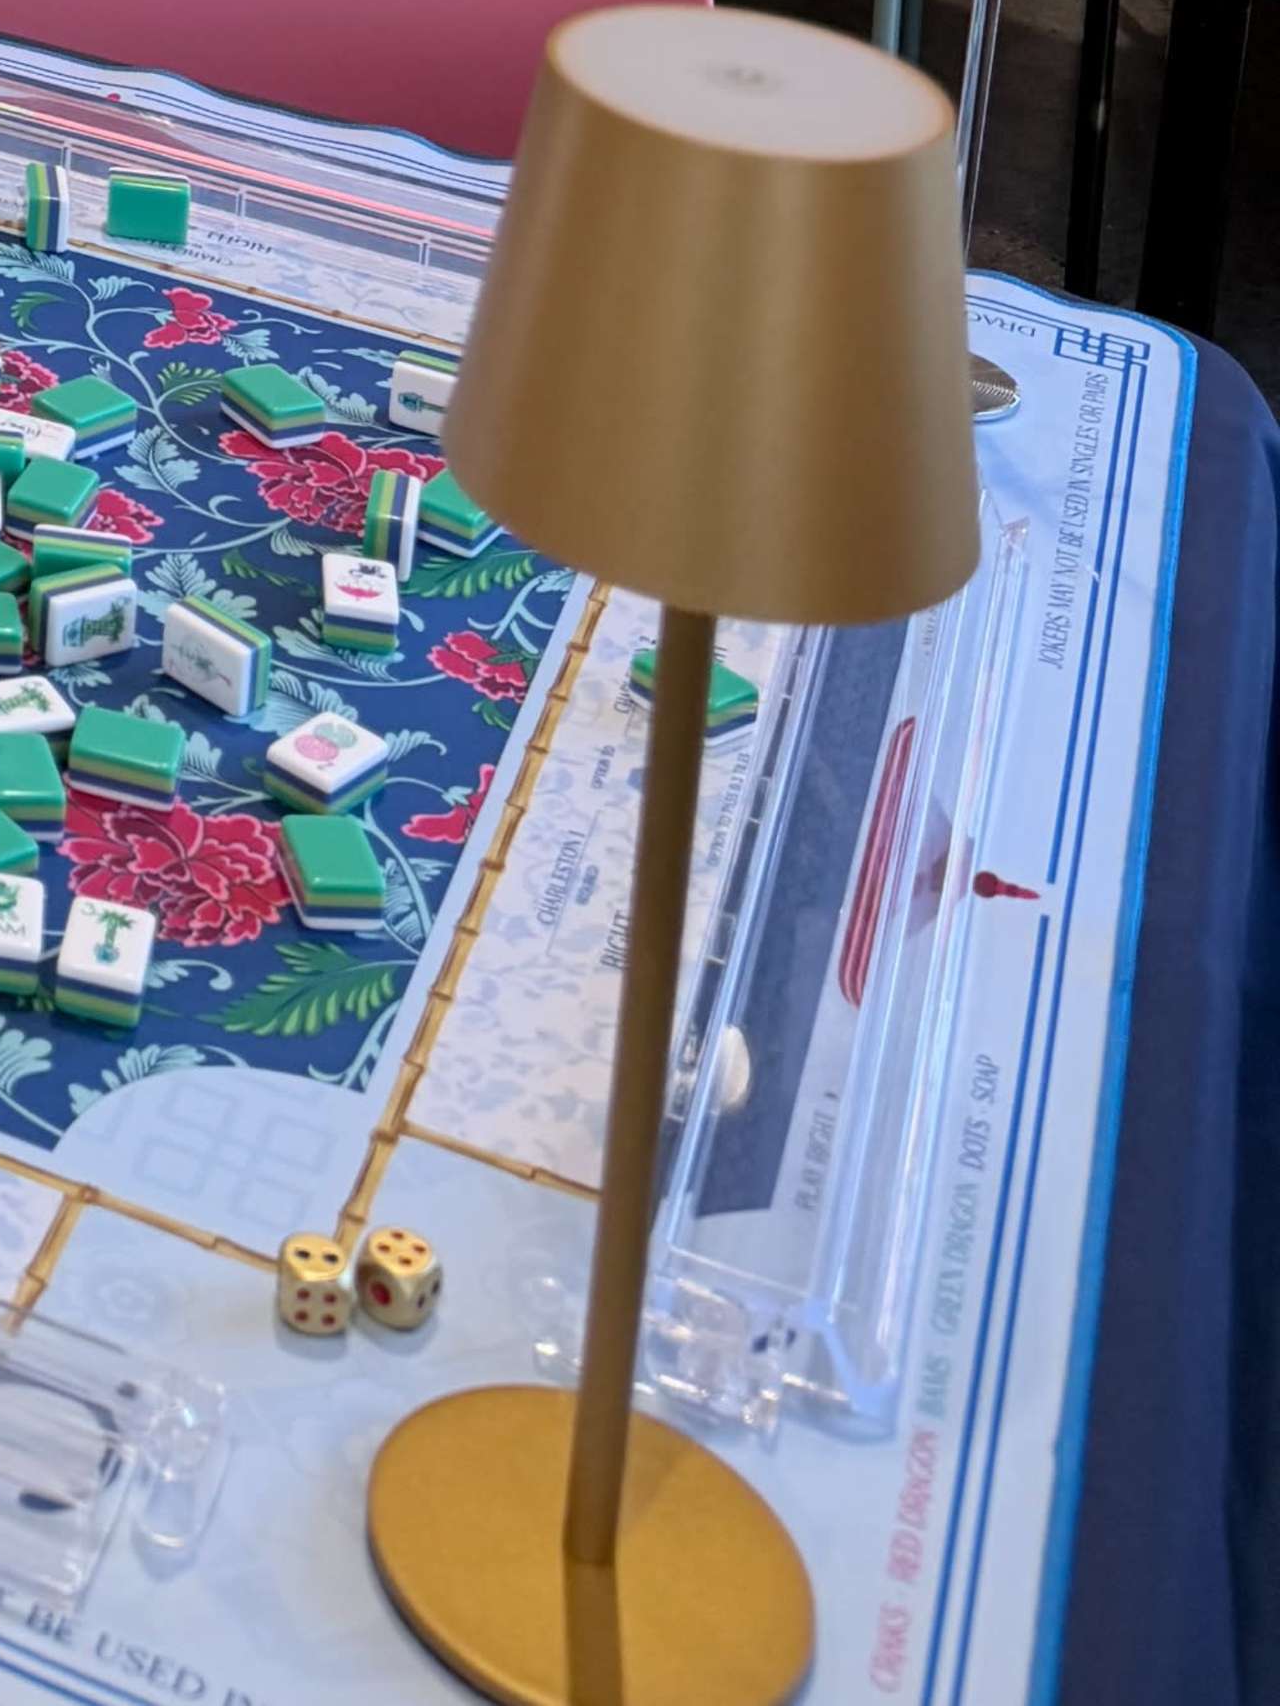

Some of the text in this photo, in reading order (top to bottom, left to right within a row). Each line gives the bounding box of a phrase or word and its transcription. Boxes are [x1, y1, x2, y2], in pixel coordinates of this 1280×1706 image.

[1080, 370, 1109, 404] PAIRS
[1079, 402, 1104, 424] OR
[1069, 423, 1101, 476] SINGLES
[1068, 476, 1091, 493] IN
[1050, 547, 1080, 578] NOT
[1061, 528, 1082, 548] BE
[1045, 576, 1076, 611] MAY
[1034, 611, 1073, 669] JOKERS
[534, 835, 582, 928] CHARLESTON
[968, 1053, 1001, 1104] SOAP
[956, 1116, 991, 1171] DOTS
[895, 1427, 940, 1530] DRAGON
[24, 1603, 79, 1646] BE
[95, 1631, 207, 1702] USED
